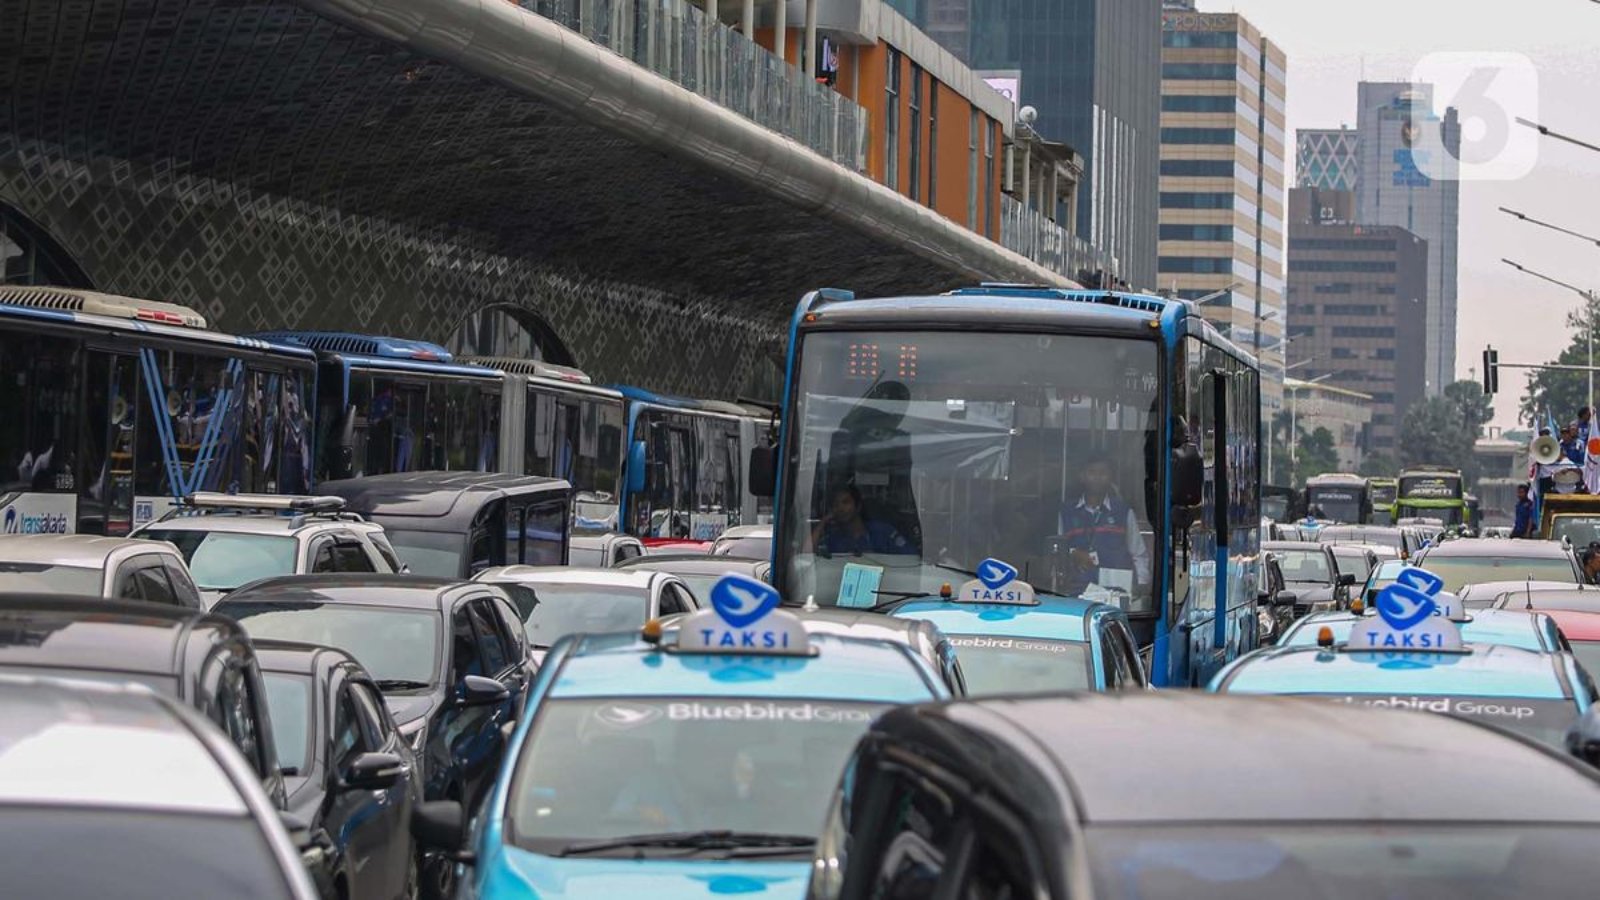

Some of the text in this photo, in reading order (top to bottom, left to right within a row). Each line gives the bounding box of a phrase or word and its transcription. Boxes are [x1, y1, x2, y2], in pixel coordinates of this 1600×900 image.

[972, 589, 1021, 601] TAKSI
[701, 629, 788, 649] TAKSI
[947, 636, 1067, 653] uebird Group
[1367, 632, 1443, 648] TAKSI
[668, 702, 873, 723] Bluebird Grou
[1455, 700, 1535, 719] Group
